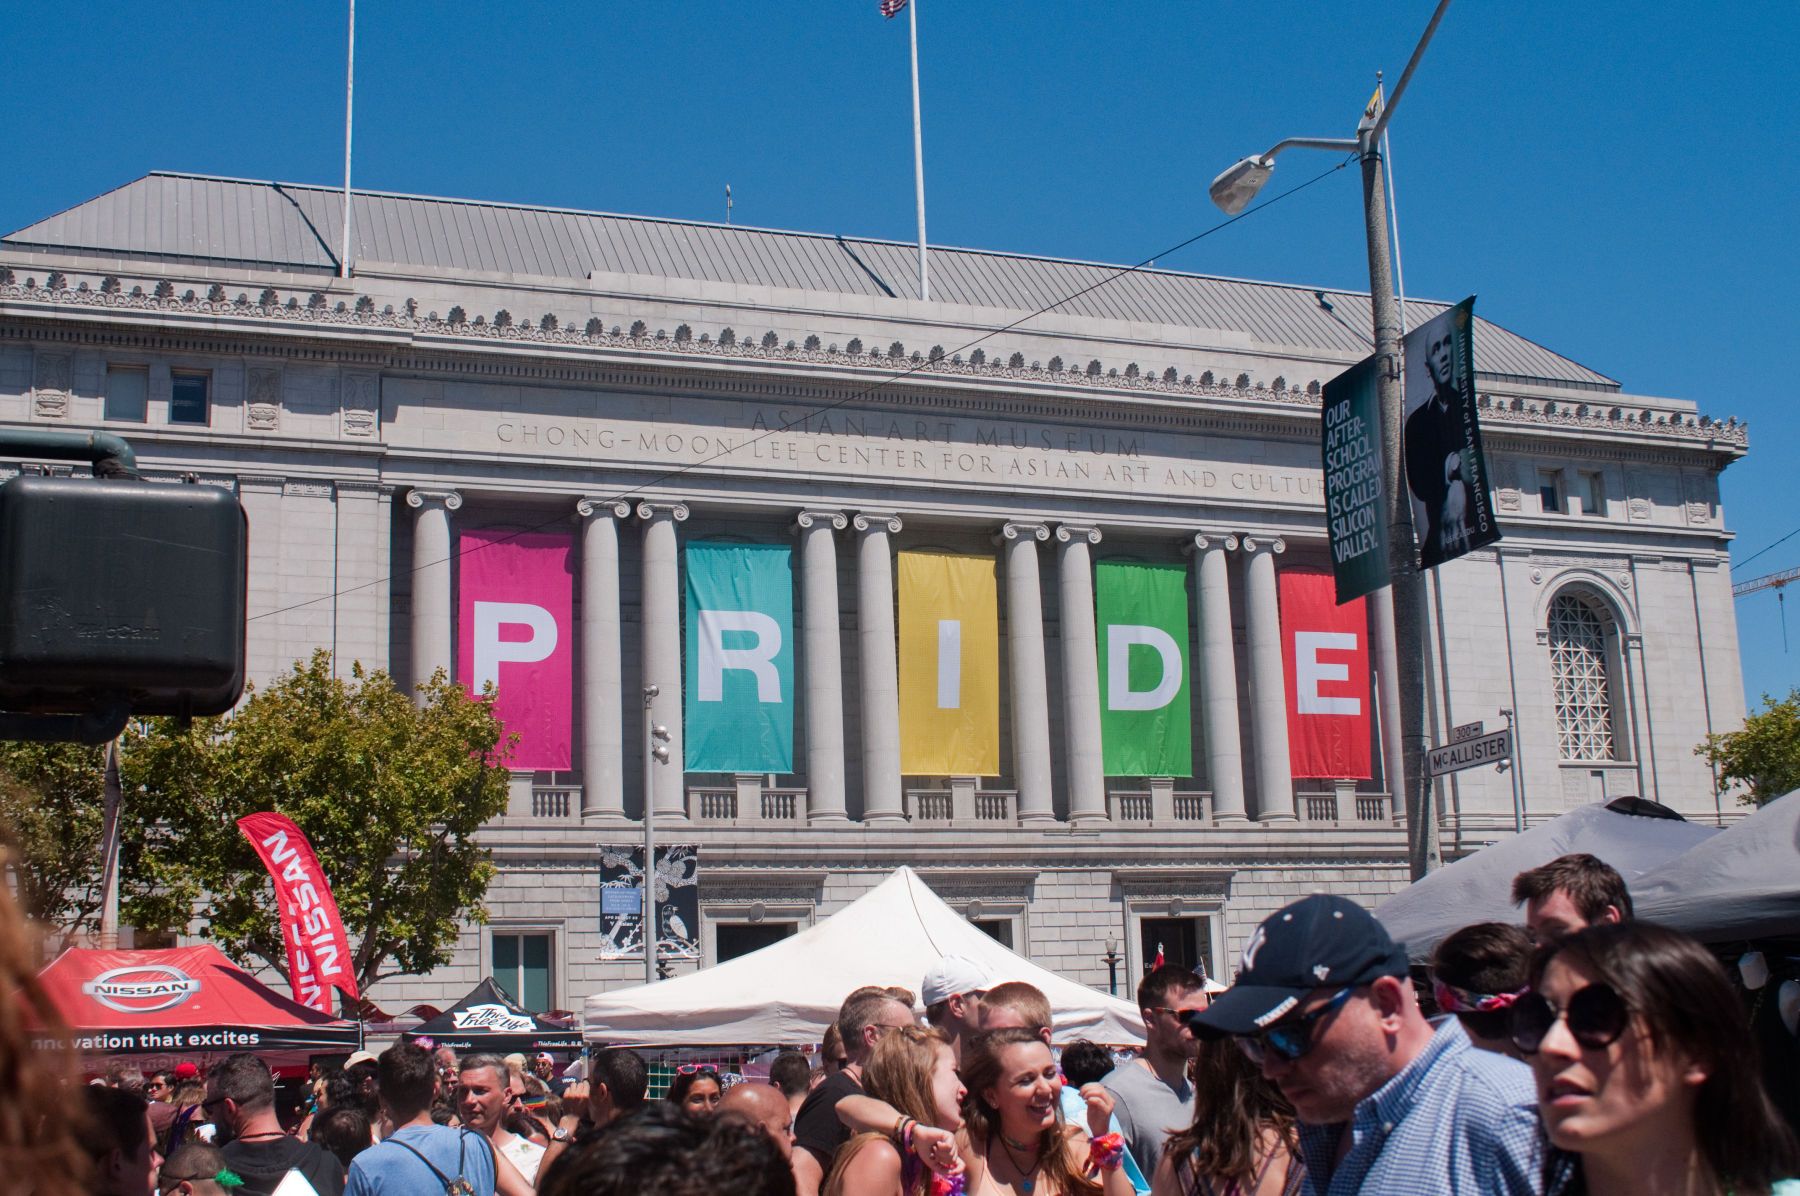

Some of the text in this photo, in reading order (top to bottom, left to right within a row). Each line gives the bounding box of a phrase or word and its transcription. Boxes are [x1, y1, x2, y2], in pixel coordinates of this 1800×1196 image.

[1326, 399, 1350, 428] OUR
[1459, 333, 1469, 408] UNIVERSITY
[1464, 427, 1475, 454] SAN
[1470, 457, 1488, 532] FRANCISCO
[752, 410, 1140, 458] ASIAN ART MUSEUM
[1326, 415, 1366, 451] AFTER-
[496, 422, 1325, 495] CHONG-MOON LEE CENTER FOR ASIAN ART AND CULTUR
[1326, 433, 1373, 473] SCHOOL
[1329, 476, 1382, 519] IS CALLED
[1332, 502, 1376, 541] SILICON
[1334, 527, 1379, 564] VALLEY.
[1455, 726, 1471, 740] 300
[262, 830, 342, 977] NISSAN
[94, 981, 190, 996] NISSAN
[140, 1032, 183, 1048] that
[188, 1030, 260, 1046] excites
[459, 1012, 530, 1030] Free Life
